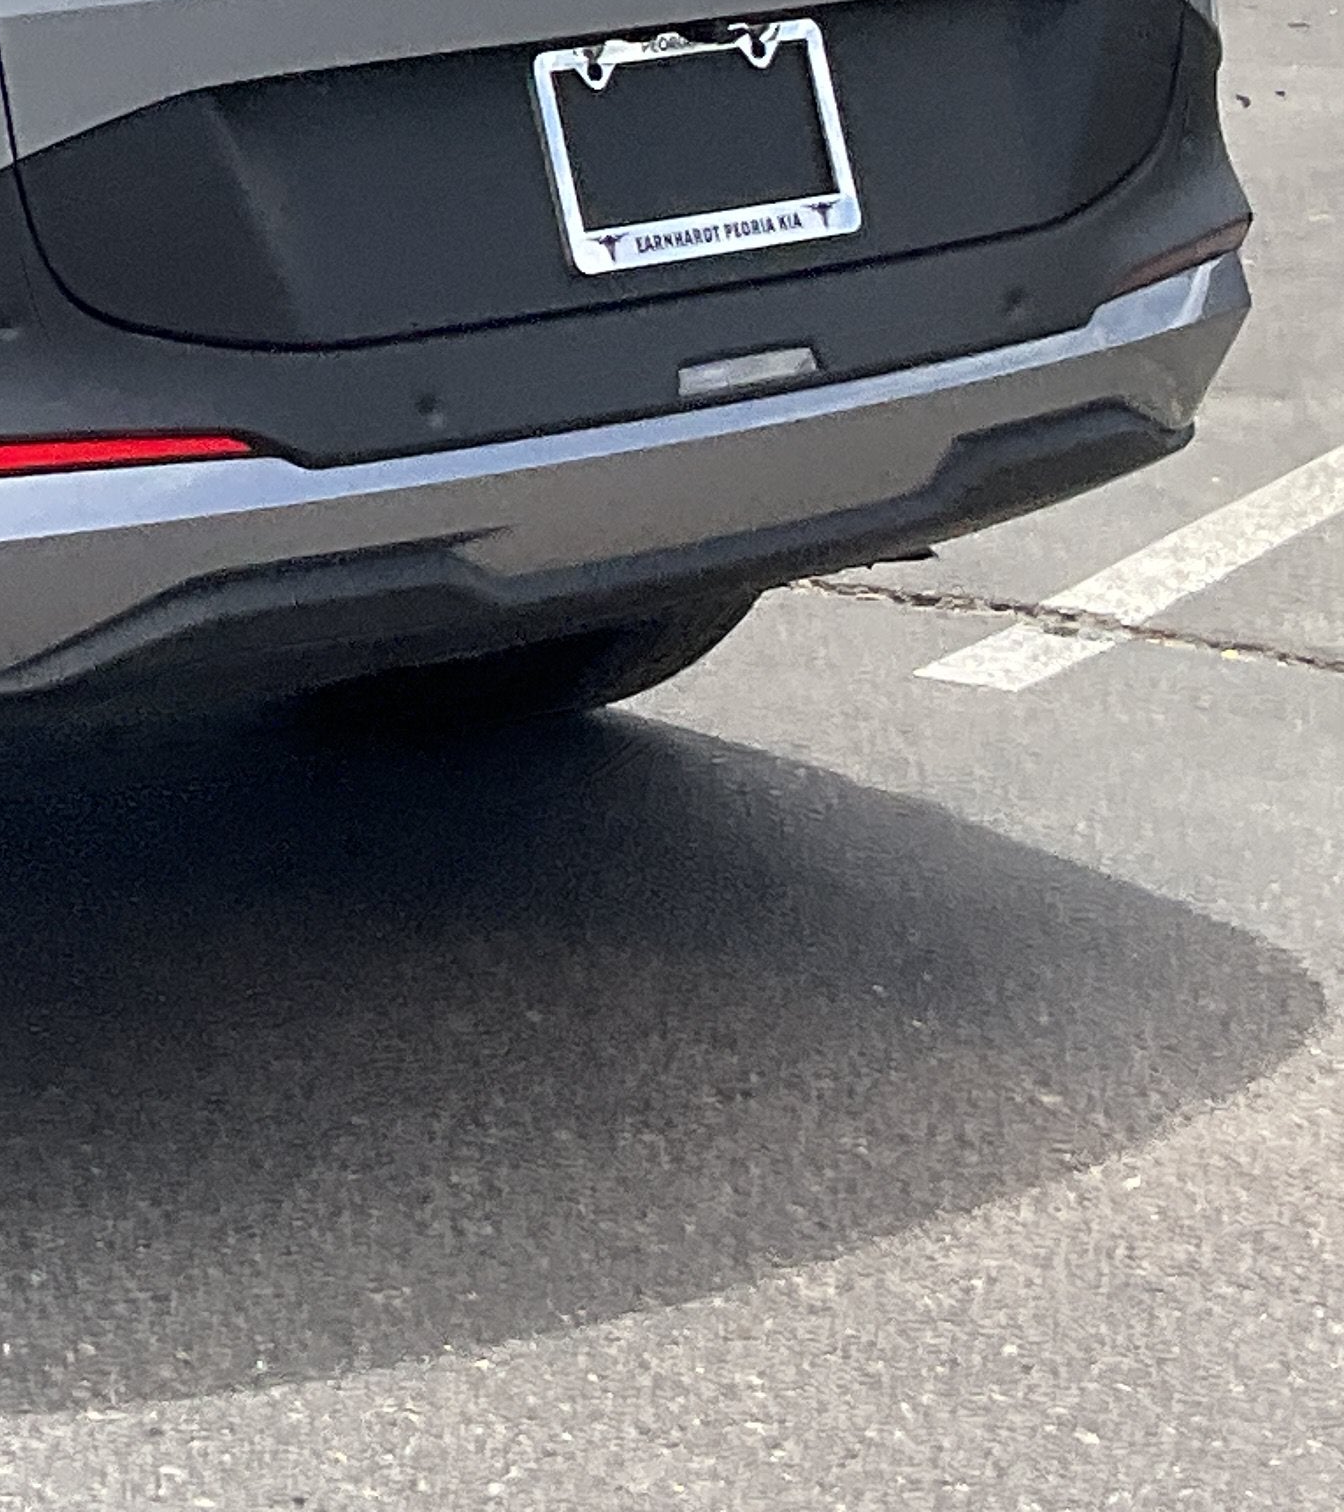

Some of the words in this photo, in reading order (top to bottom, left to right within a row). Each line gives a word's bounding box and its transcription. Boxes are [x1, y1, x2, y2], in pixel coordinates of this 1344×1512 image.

[635, 225, 720, 254] EARNHARDT
[723, 217, 776, 239] PEORIA
[777, 212, 803, 231] KIA
